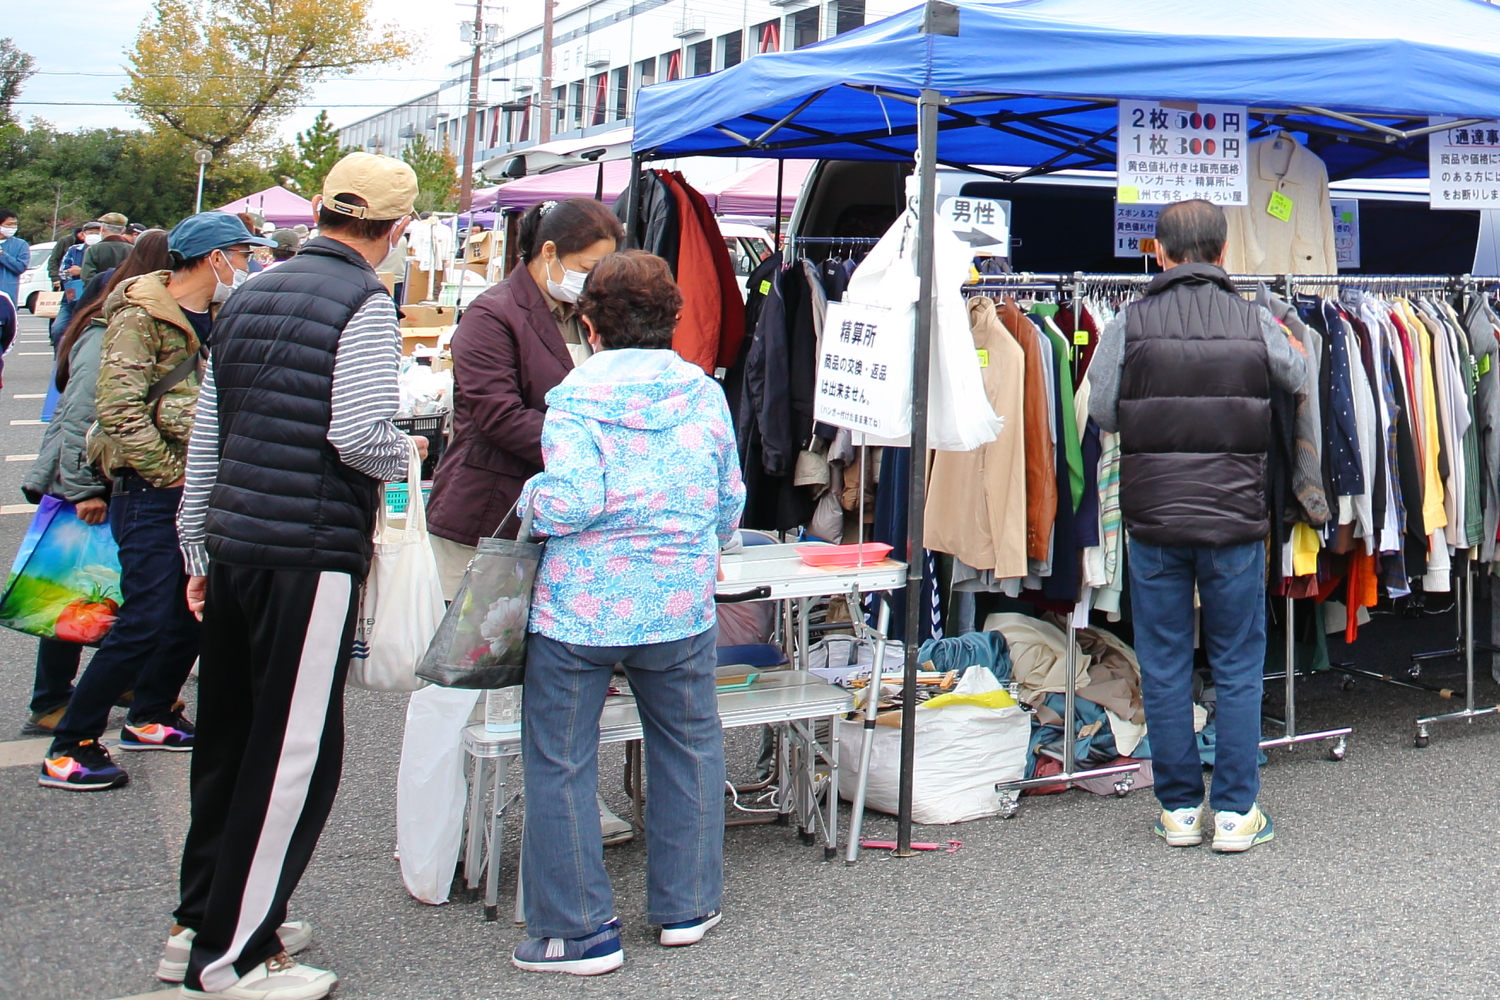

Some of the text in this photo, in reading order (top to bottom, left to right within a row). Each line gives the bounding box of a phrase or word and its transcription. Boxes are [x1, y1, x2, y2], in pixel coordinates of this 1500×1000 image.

[1127, 160, 1239, 175] 黄色値札付きは販売価格
[1134, 175, 1235, 187] ハンガー共・精算所に
[952, 199, 995, 225] 男性
[839, 319, 878, 348] 精算所
[823, 353, 888, 382] 商品の交換・返品
[820, 379, 870, 406] は出来ません。
